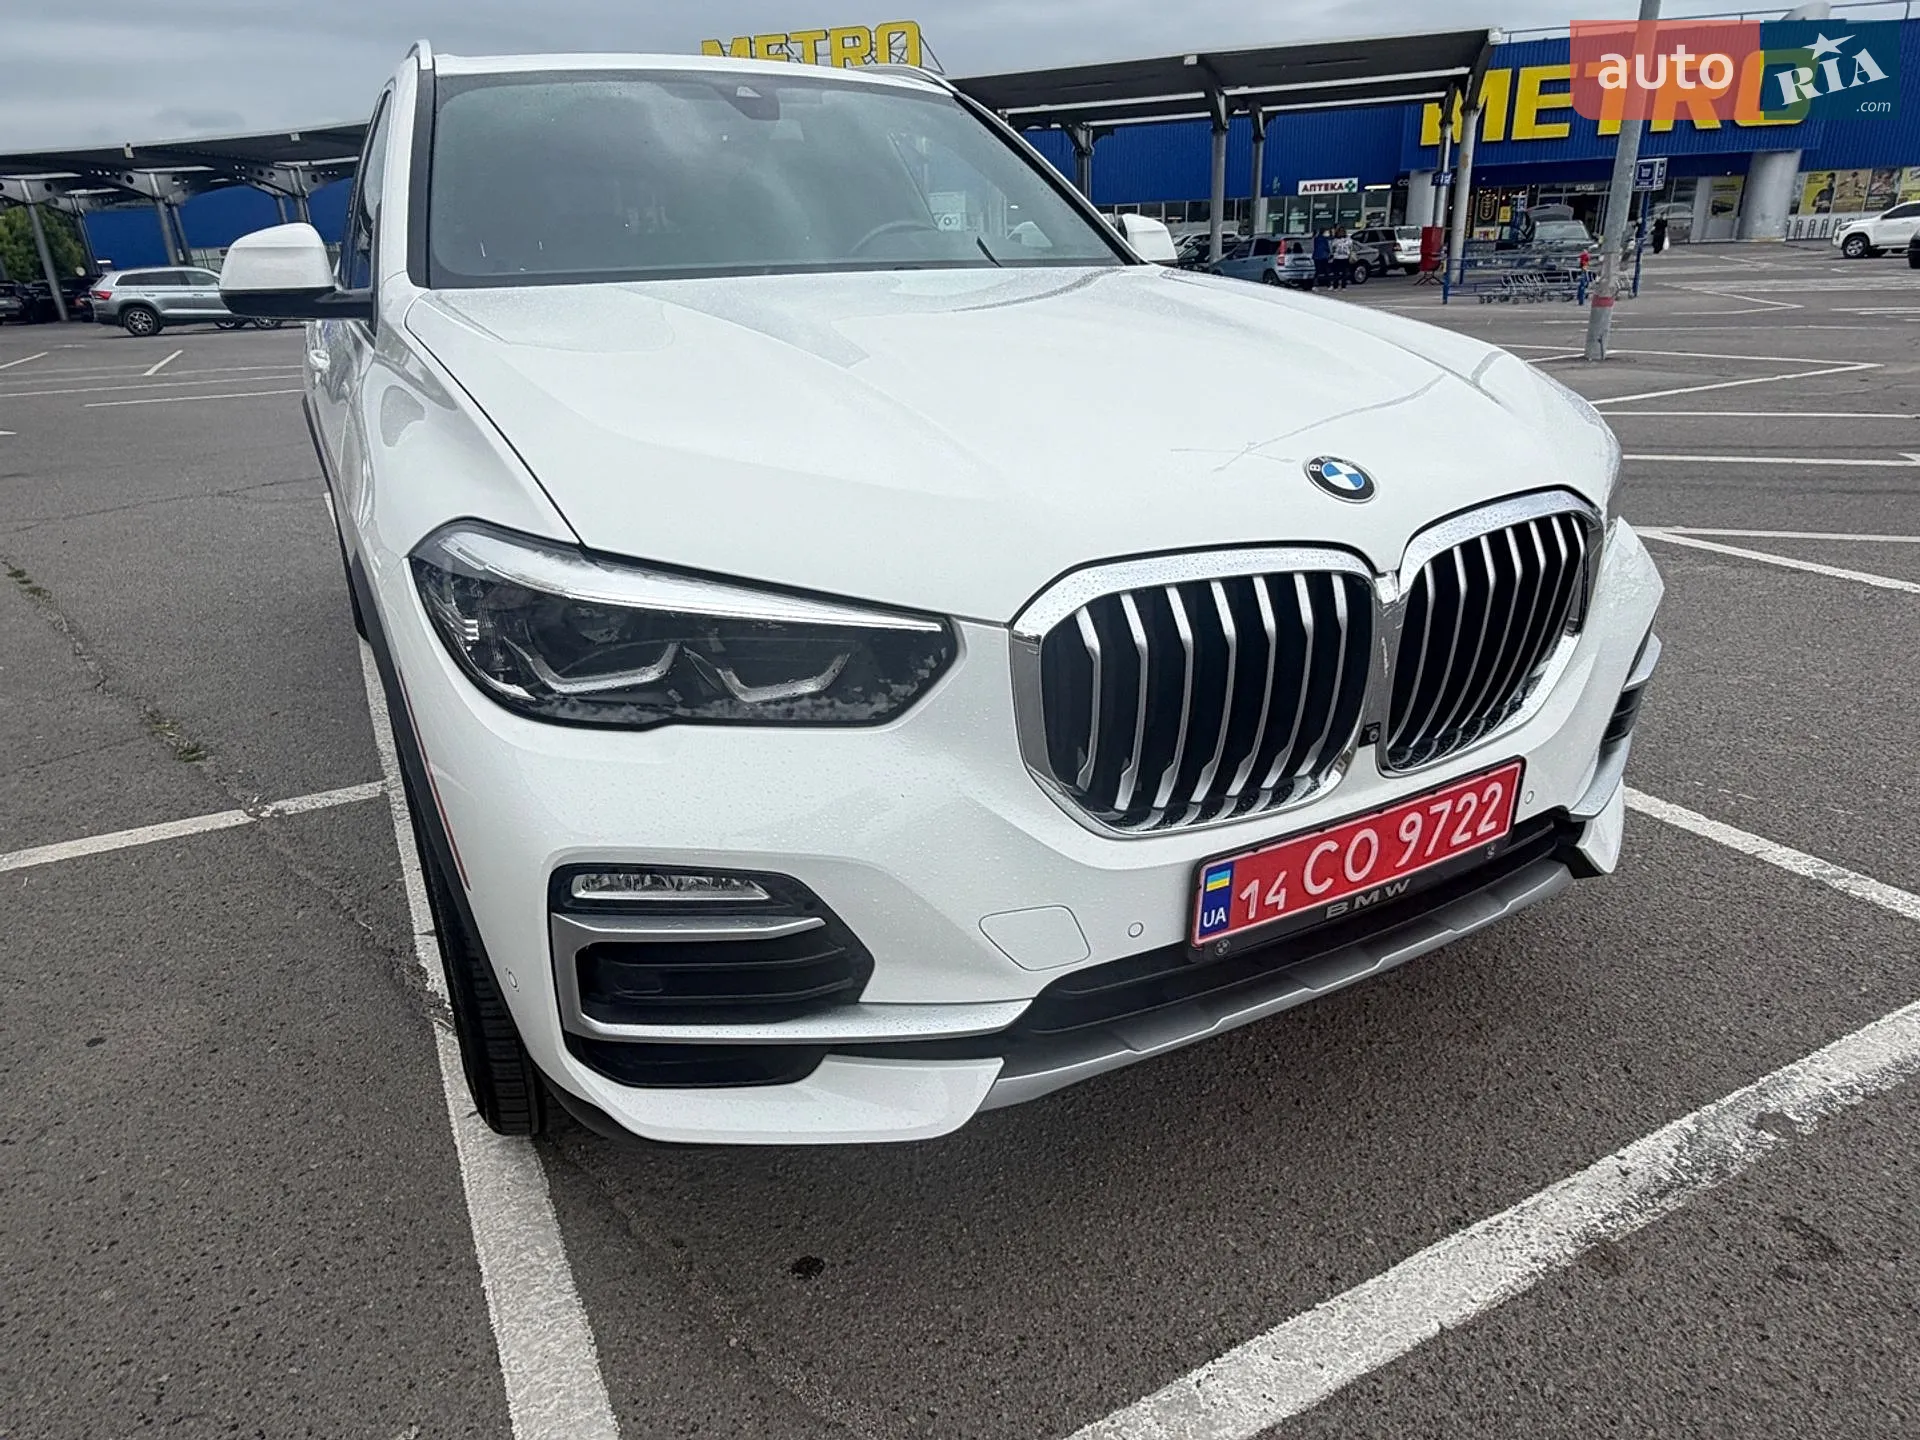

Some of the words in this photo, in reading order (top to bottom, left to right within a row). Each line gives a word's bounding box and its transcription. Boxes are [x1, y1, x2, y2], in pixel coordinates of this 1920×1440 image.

[1420, 48, 1819, 146] METRO
[1301, 182, 1344, 192] АПТЕКА
[1239, 870, 1288, 920] 14
[1303, 827, 1379, 895] CO
[1395, 782, 1503, 868] 9722
[1203, 906, 1227, 928] UA
[1325, 878, 1412, 920] BMW
